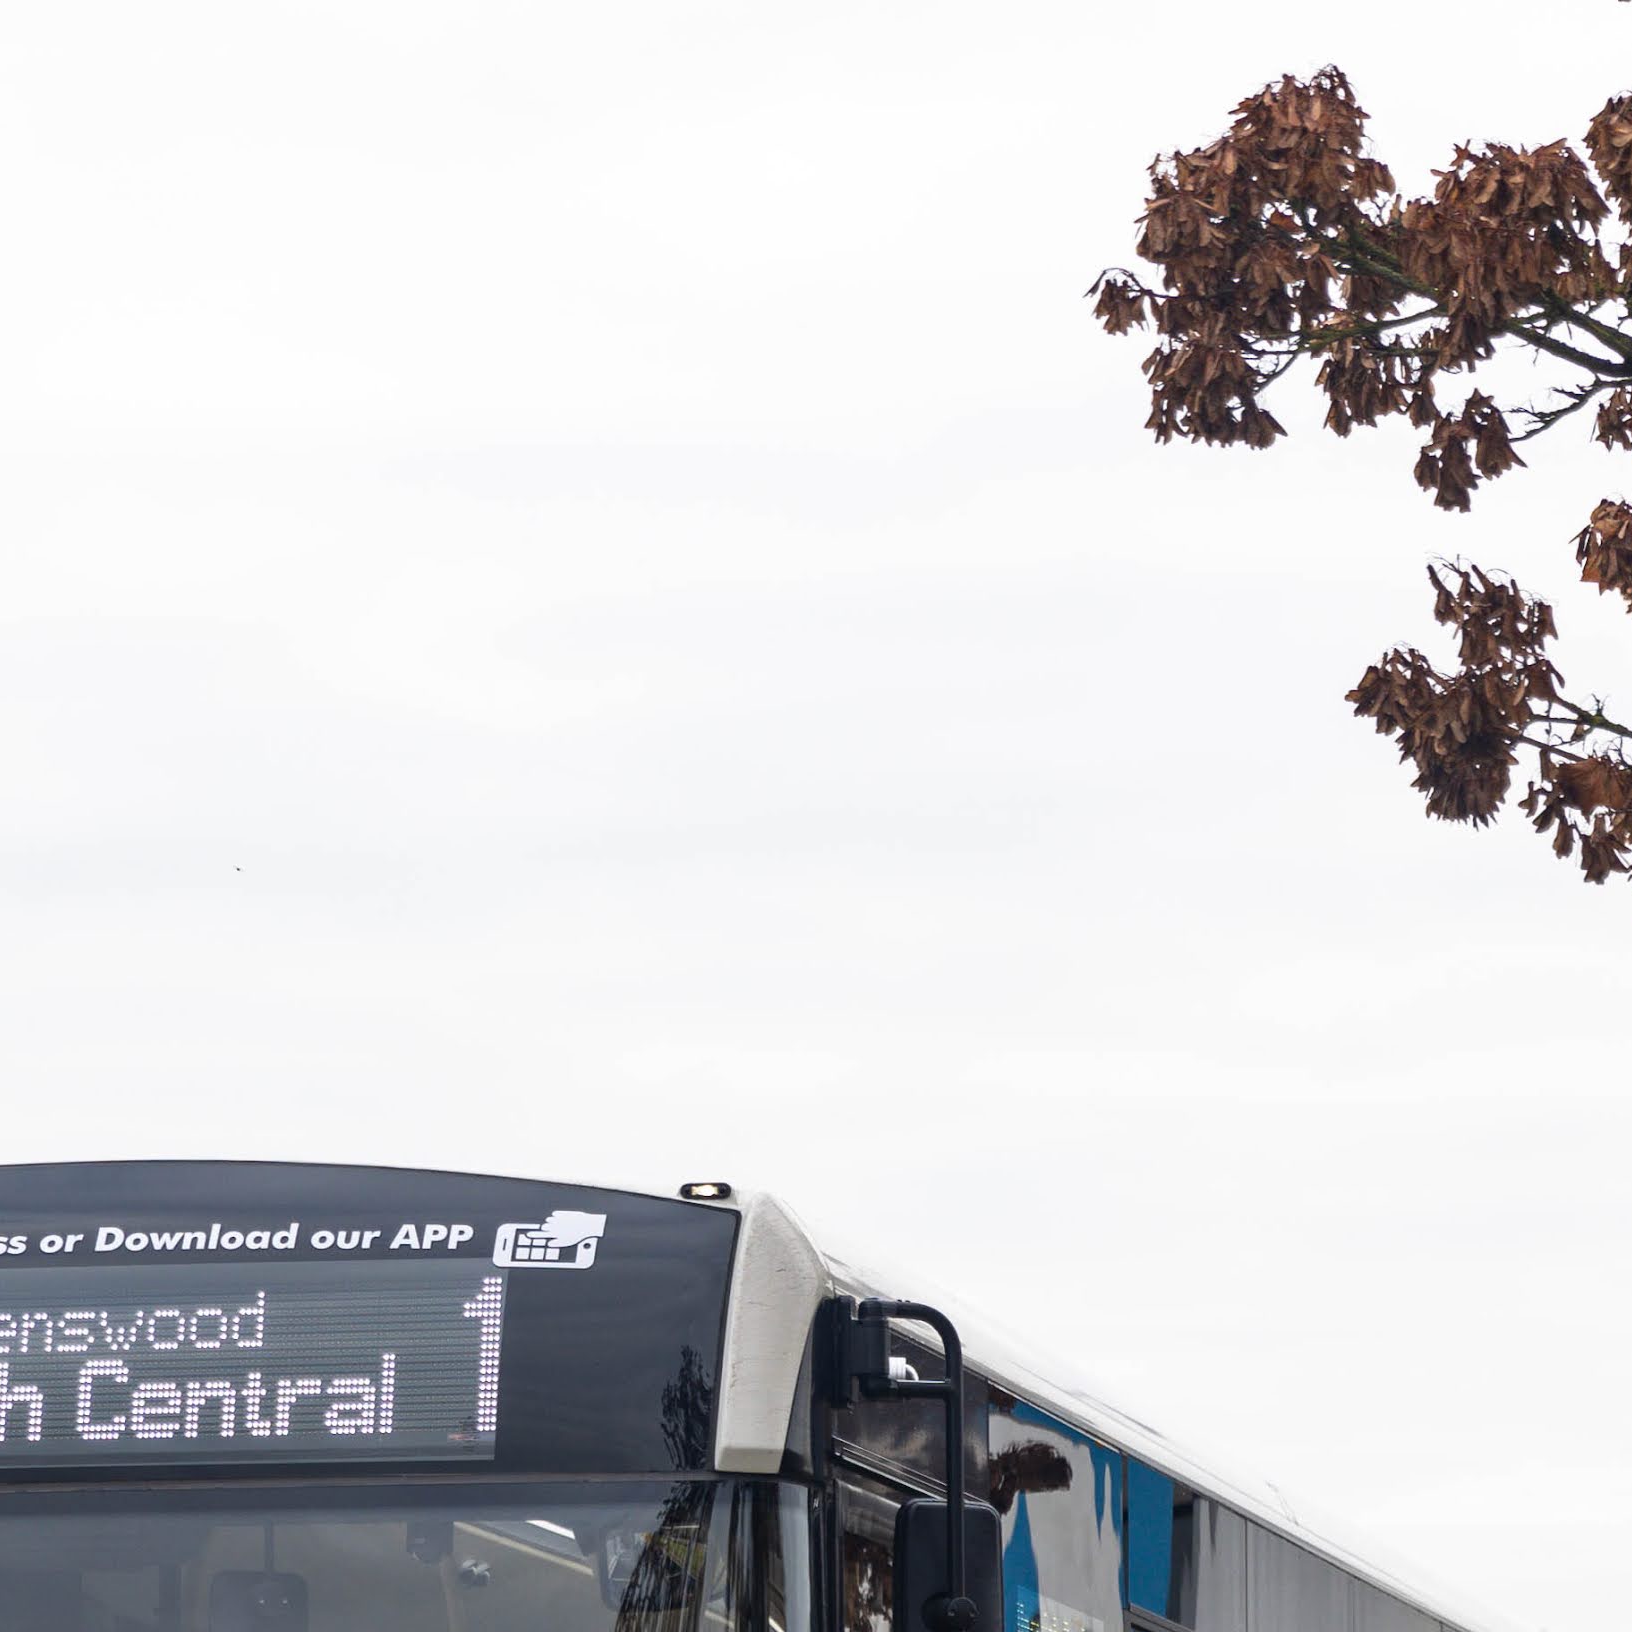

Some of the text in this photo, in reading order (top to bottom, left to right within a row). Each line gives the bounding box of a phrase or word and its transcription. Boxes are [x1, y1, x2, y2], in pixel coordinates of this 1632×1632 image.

[40, 1230, 84, 1253] or
[94, 1223, 300, 1252] Download
[311, 1227, 381, 1250] our
[391, 1224, 474, 1250] APP
[76, 1353, 396, 1440] Central
[463, 1276, 503, 1433] 1
